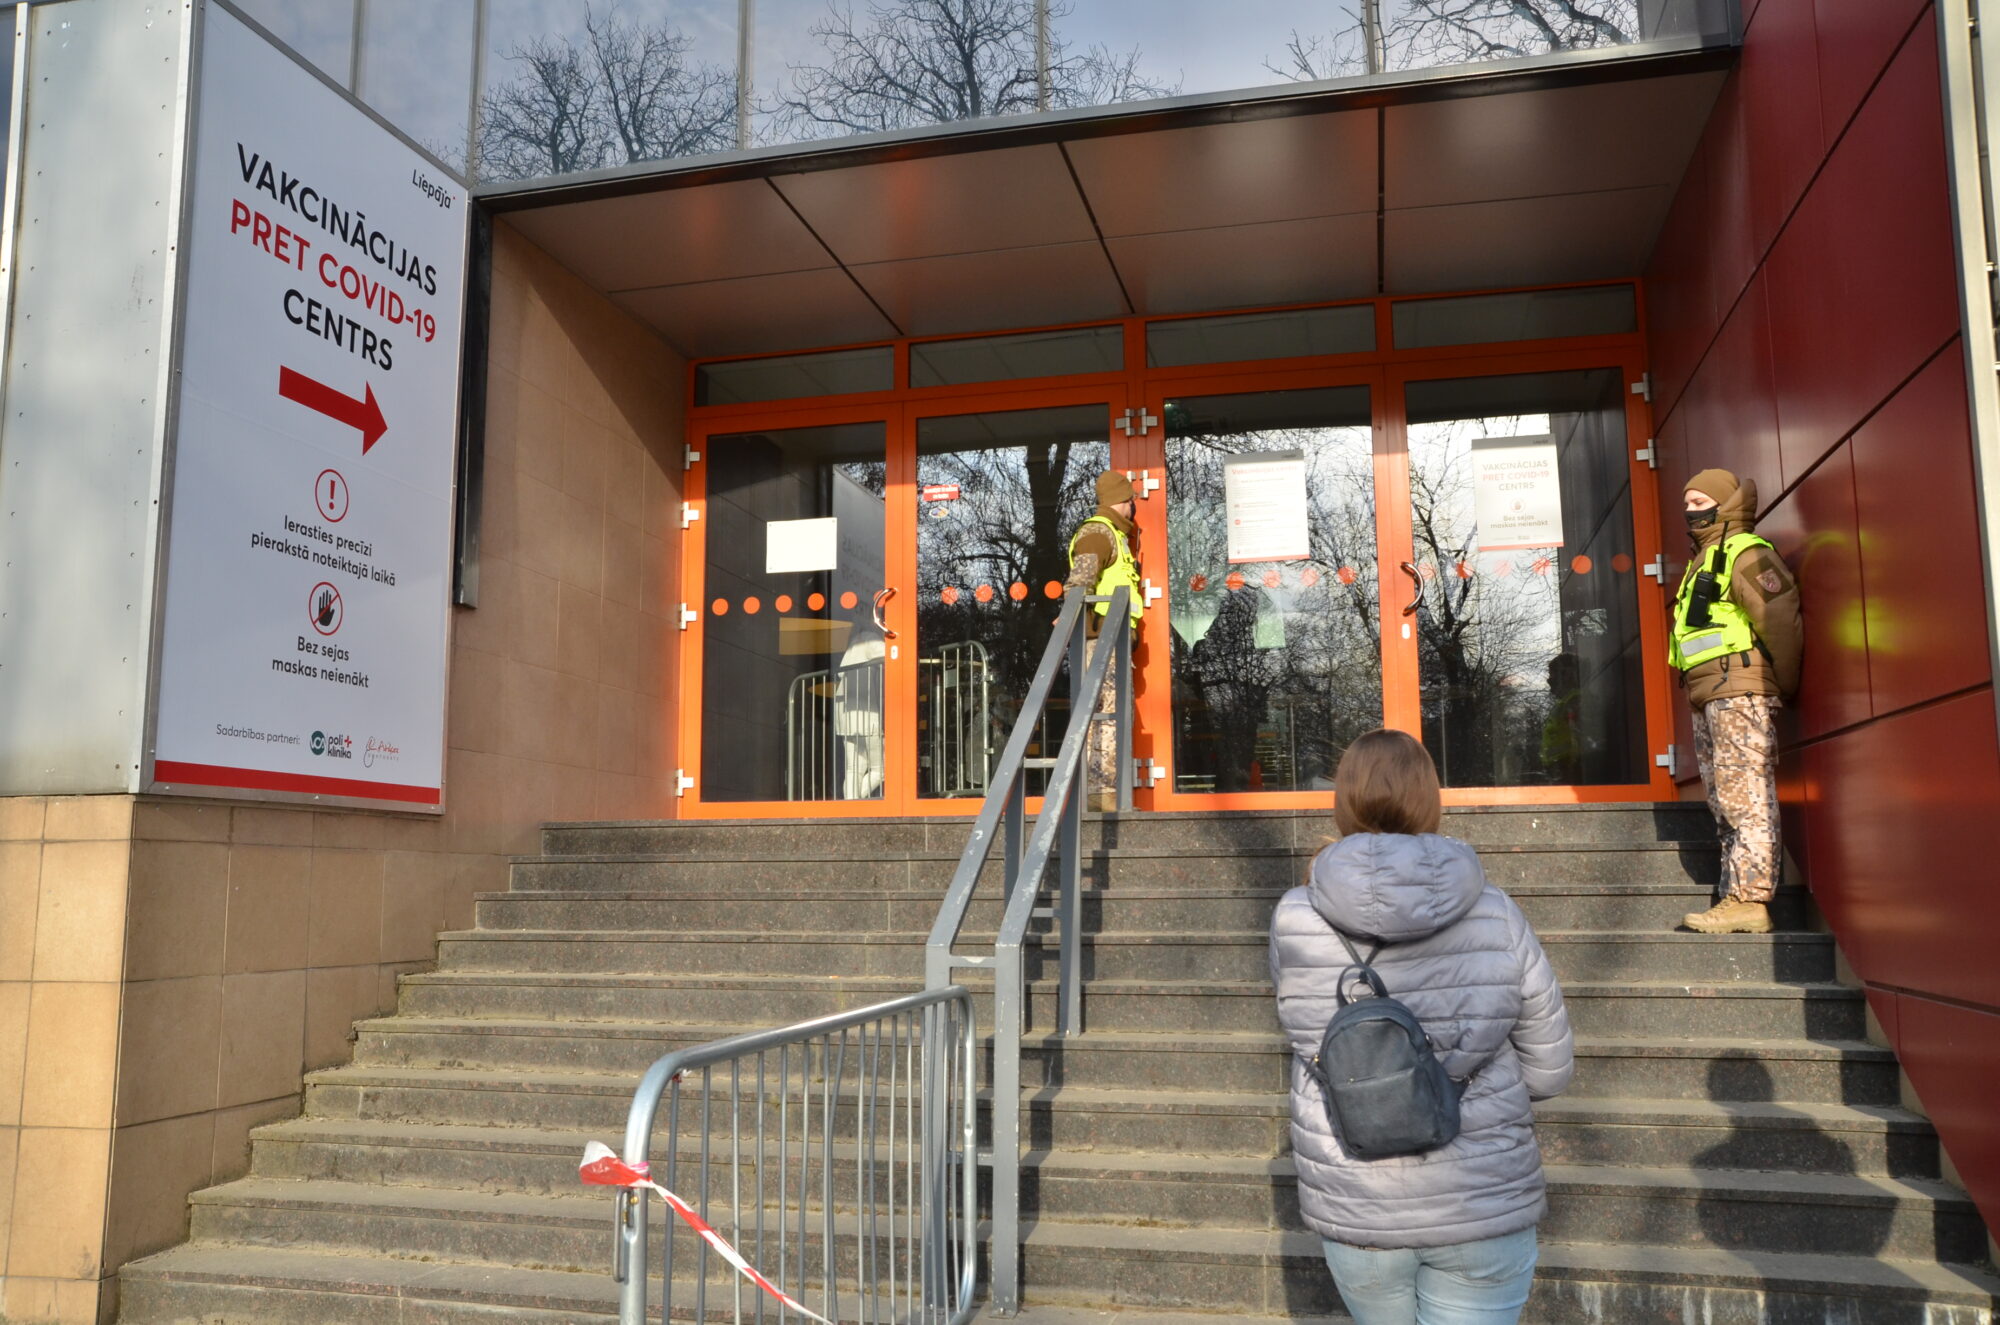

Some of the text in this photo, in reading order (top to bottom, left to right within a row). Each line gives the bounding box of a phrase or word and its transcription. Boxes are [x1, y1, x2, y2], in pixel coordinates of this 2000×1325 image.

[412, 169, 451, 209] Liepāja
[237, 142, 438, 296] VAKCINĀCIJAS
[230, 198, 437, 343] PRET COVID-19
[283, 289, 393, 371] CENTRS
[1482, 470, 1550, 481] PRET COVID-19
[1498, 481, 1535, 491] CENTRS
[284, 515, 372, 557] Ierasties precīzi
[251, 531, 395, 586] pierakstā noteiktajā laikā
[297, 635, 349, 662] Bez sejas
[272, 659, 369, 688] maskas neienākt
[216, 723, 265, 741] Sadarbības
[327, 745, 352, 759] klinika
